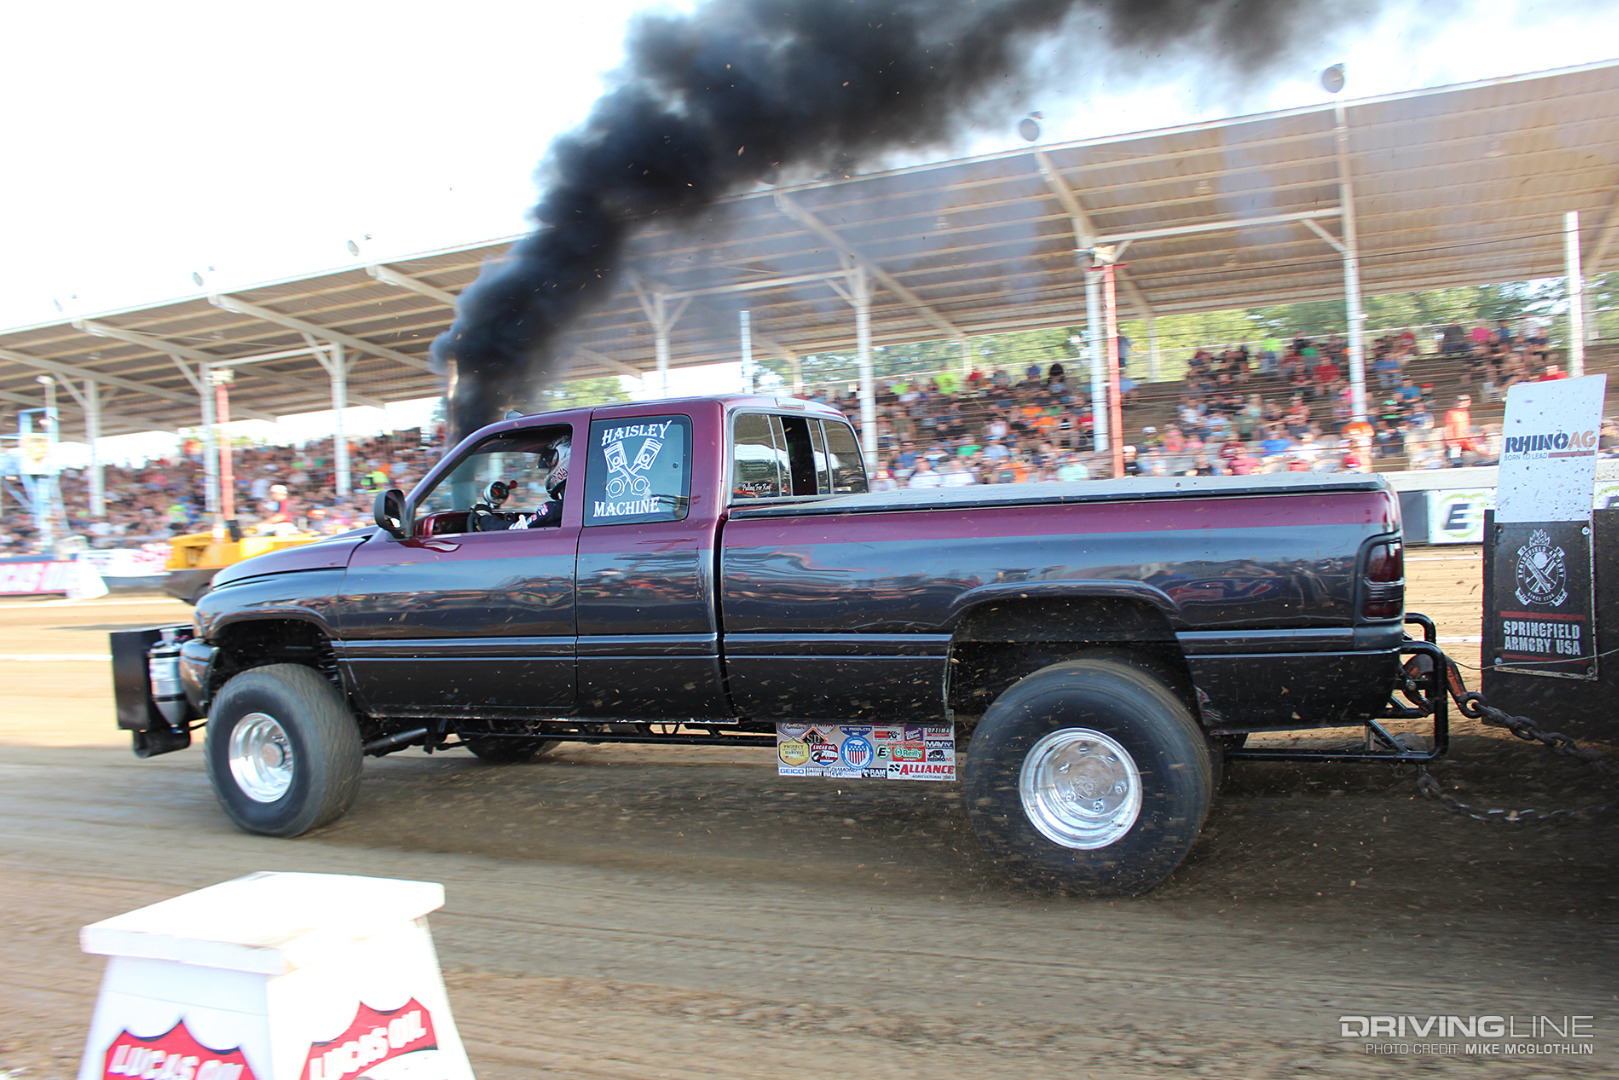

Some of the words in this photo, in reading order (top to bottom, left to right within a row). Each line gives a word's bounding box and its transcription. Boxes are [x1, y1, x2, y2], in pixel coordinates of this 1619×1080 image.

[601, 420, 672, 446] HAISLEY
[1532, 452, 1548, 460] LEAD
[593, 497, 660, 518] MACHINE
[1503, 620, 1581, 640] SPRINGFIELD
[1504, 635, 1552, 654] ARMORY
[1555, 638, 1582, 656] USA
[900, 764, 954, 775] ALLIANCE
[309, 1027, 389, 1080] LUCAS
[388, 1010, 427, 1049] OIL
[107, 1044, 200, 1080] LUCAS
